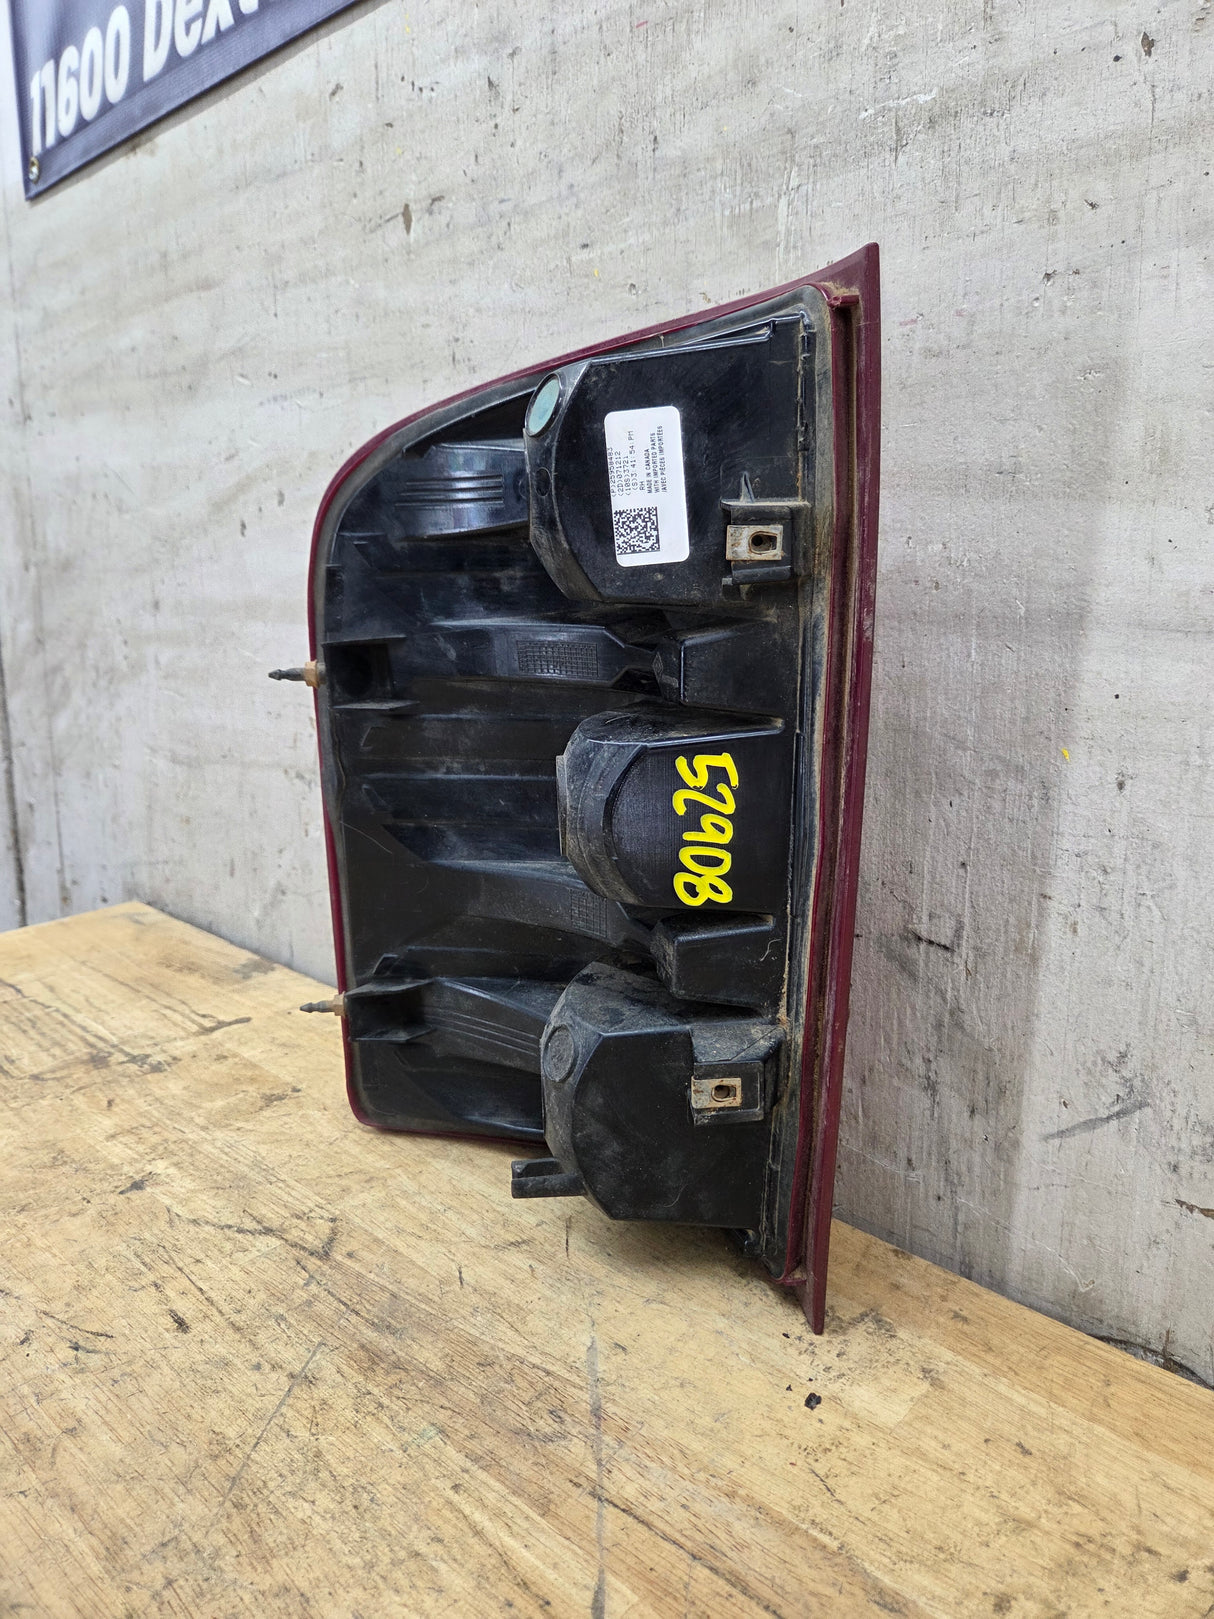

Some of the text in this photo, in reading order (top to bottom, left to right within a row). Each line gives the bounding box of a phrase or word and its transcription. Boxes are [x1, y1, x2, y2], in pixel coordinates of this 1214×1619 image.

[30, 0, 259, 155] 11600 Dex
[639, 480, 645, 491] RH
[651, 451, 659, 478] IMPORTED
[672, 752, 739, 907] 52908
